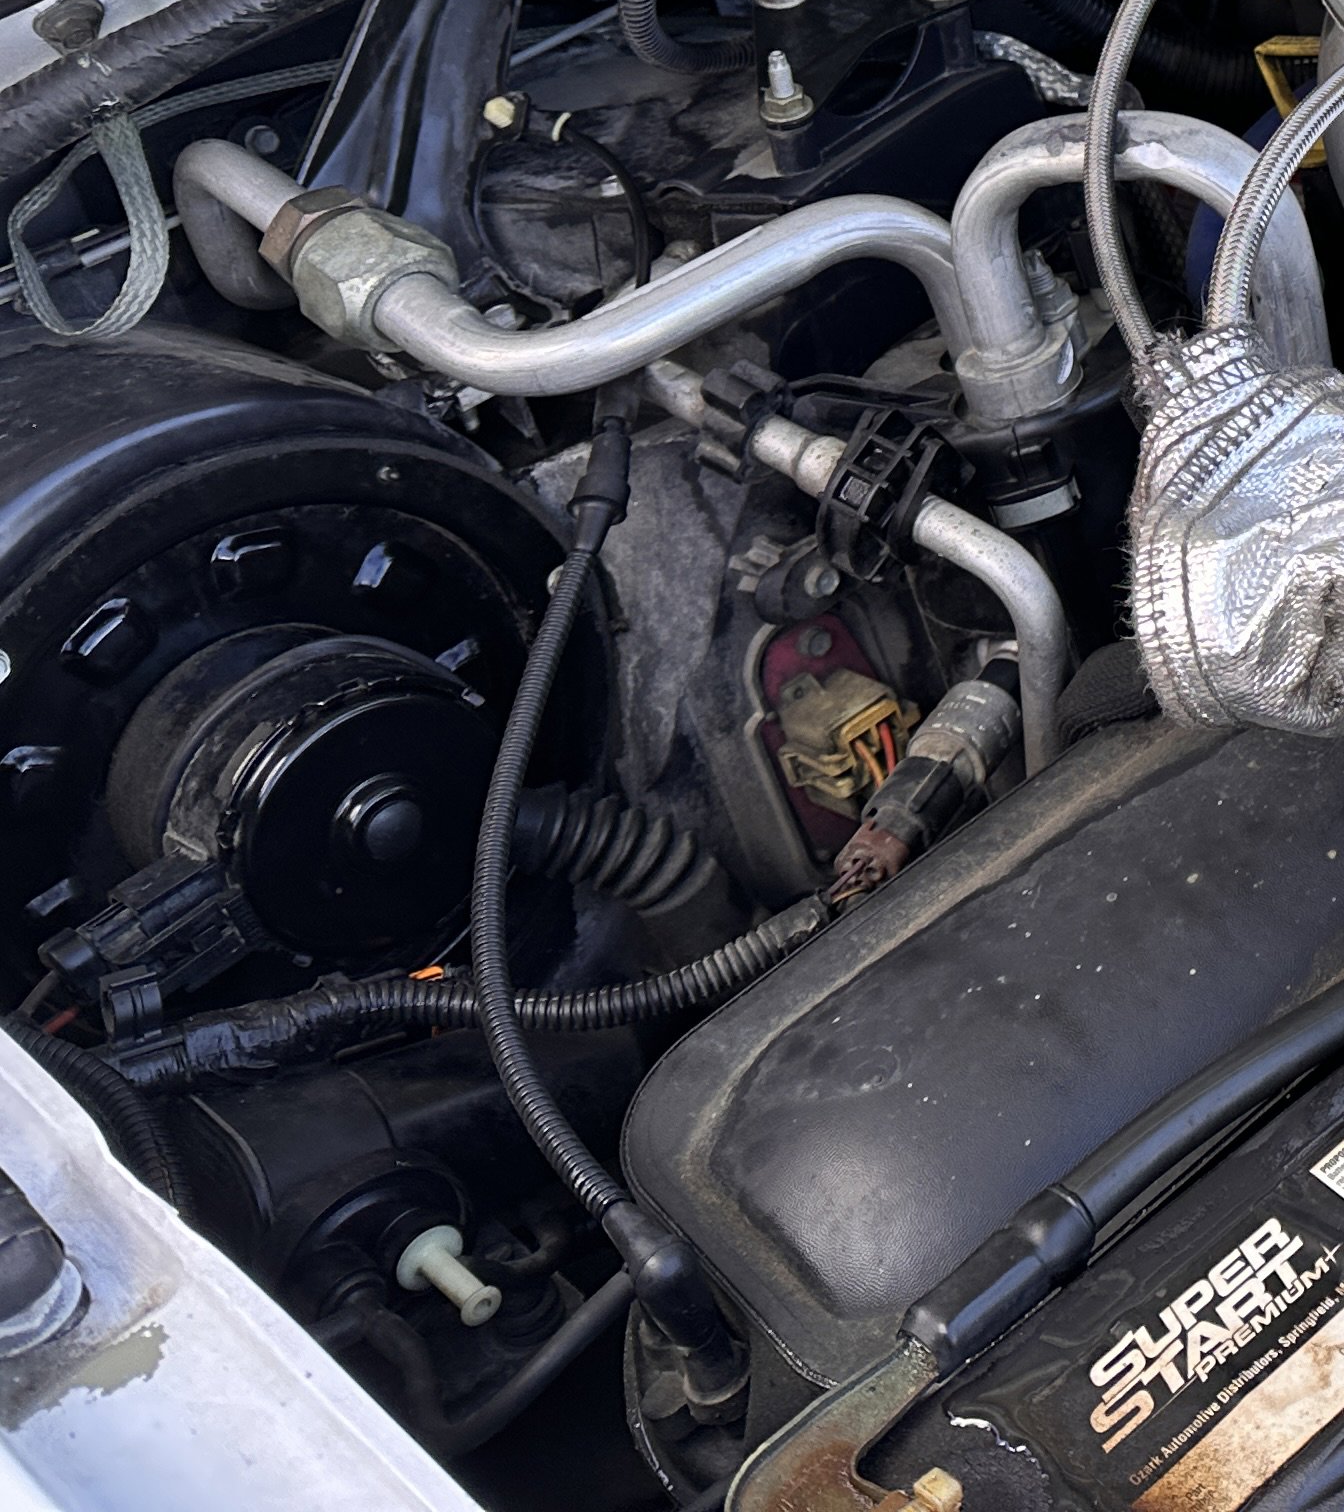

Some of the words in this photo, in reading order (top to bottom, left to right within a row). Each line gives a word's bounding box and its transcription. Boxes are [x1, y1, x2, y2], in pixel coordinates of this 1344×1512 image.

[1089, 1234, 1306, 1452] START
[1090, 1217, 1292, 1393] SUPER
[1128, 1452, 1165, 1487] Ozark
[1158, 1398, 1222, 1458] Automotive
[1215, 1342, 1283, 1406] Distributors,
[1276, 1290, 1342, 1351] Springfield,
